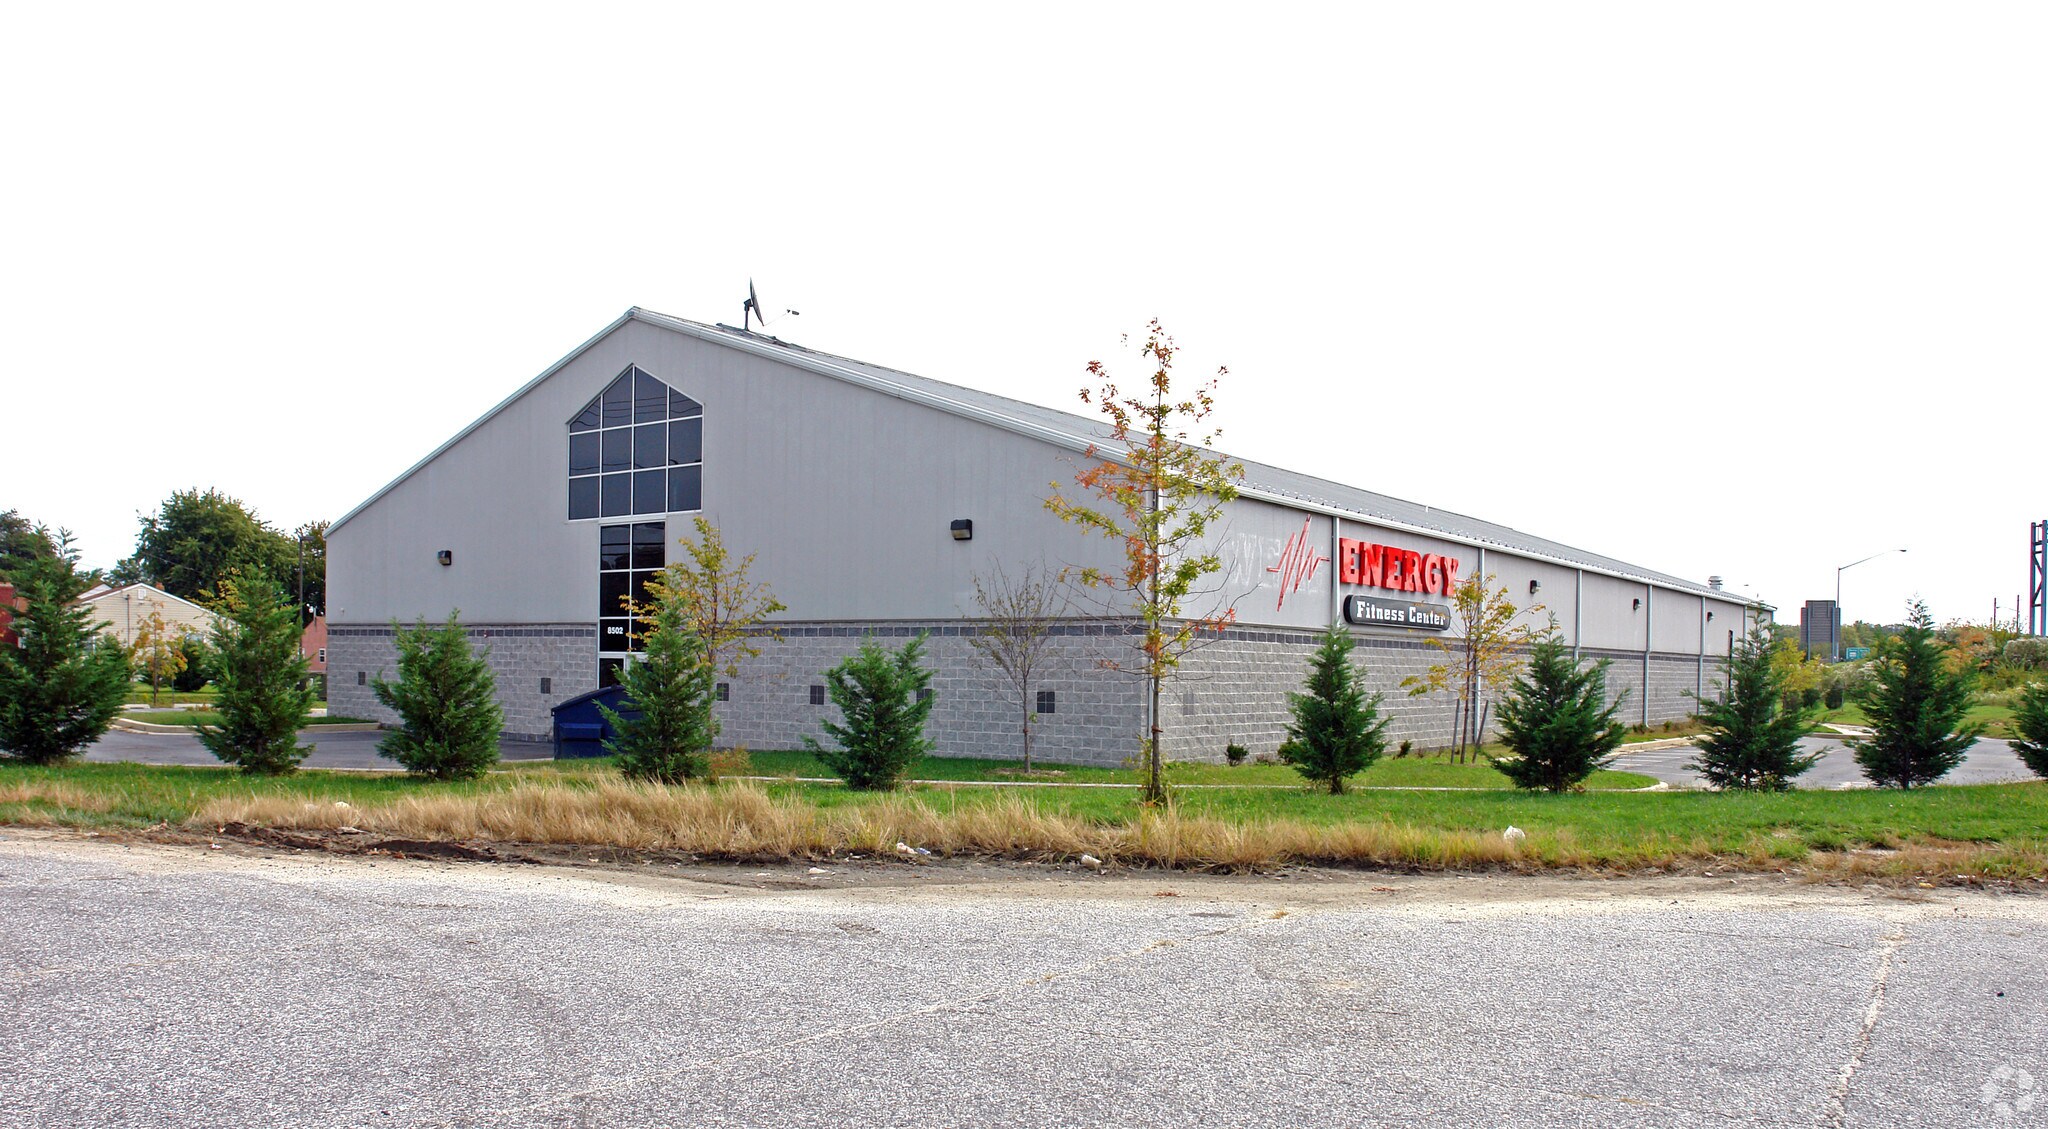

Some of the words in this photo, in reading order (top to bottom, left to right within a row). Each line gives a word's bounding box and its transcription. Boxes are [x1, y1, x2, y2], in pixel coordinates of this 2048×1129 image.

[1339, 538, 1458, 596] ENERGY
[1356, 600, 1404, 622] Fitness
[1408, 606, 1446, 626] Center
[607, 626, 623, 634] 8502
